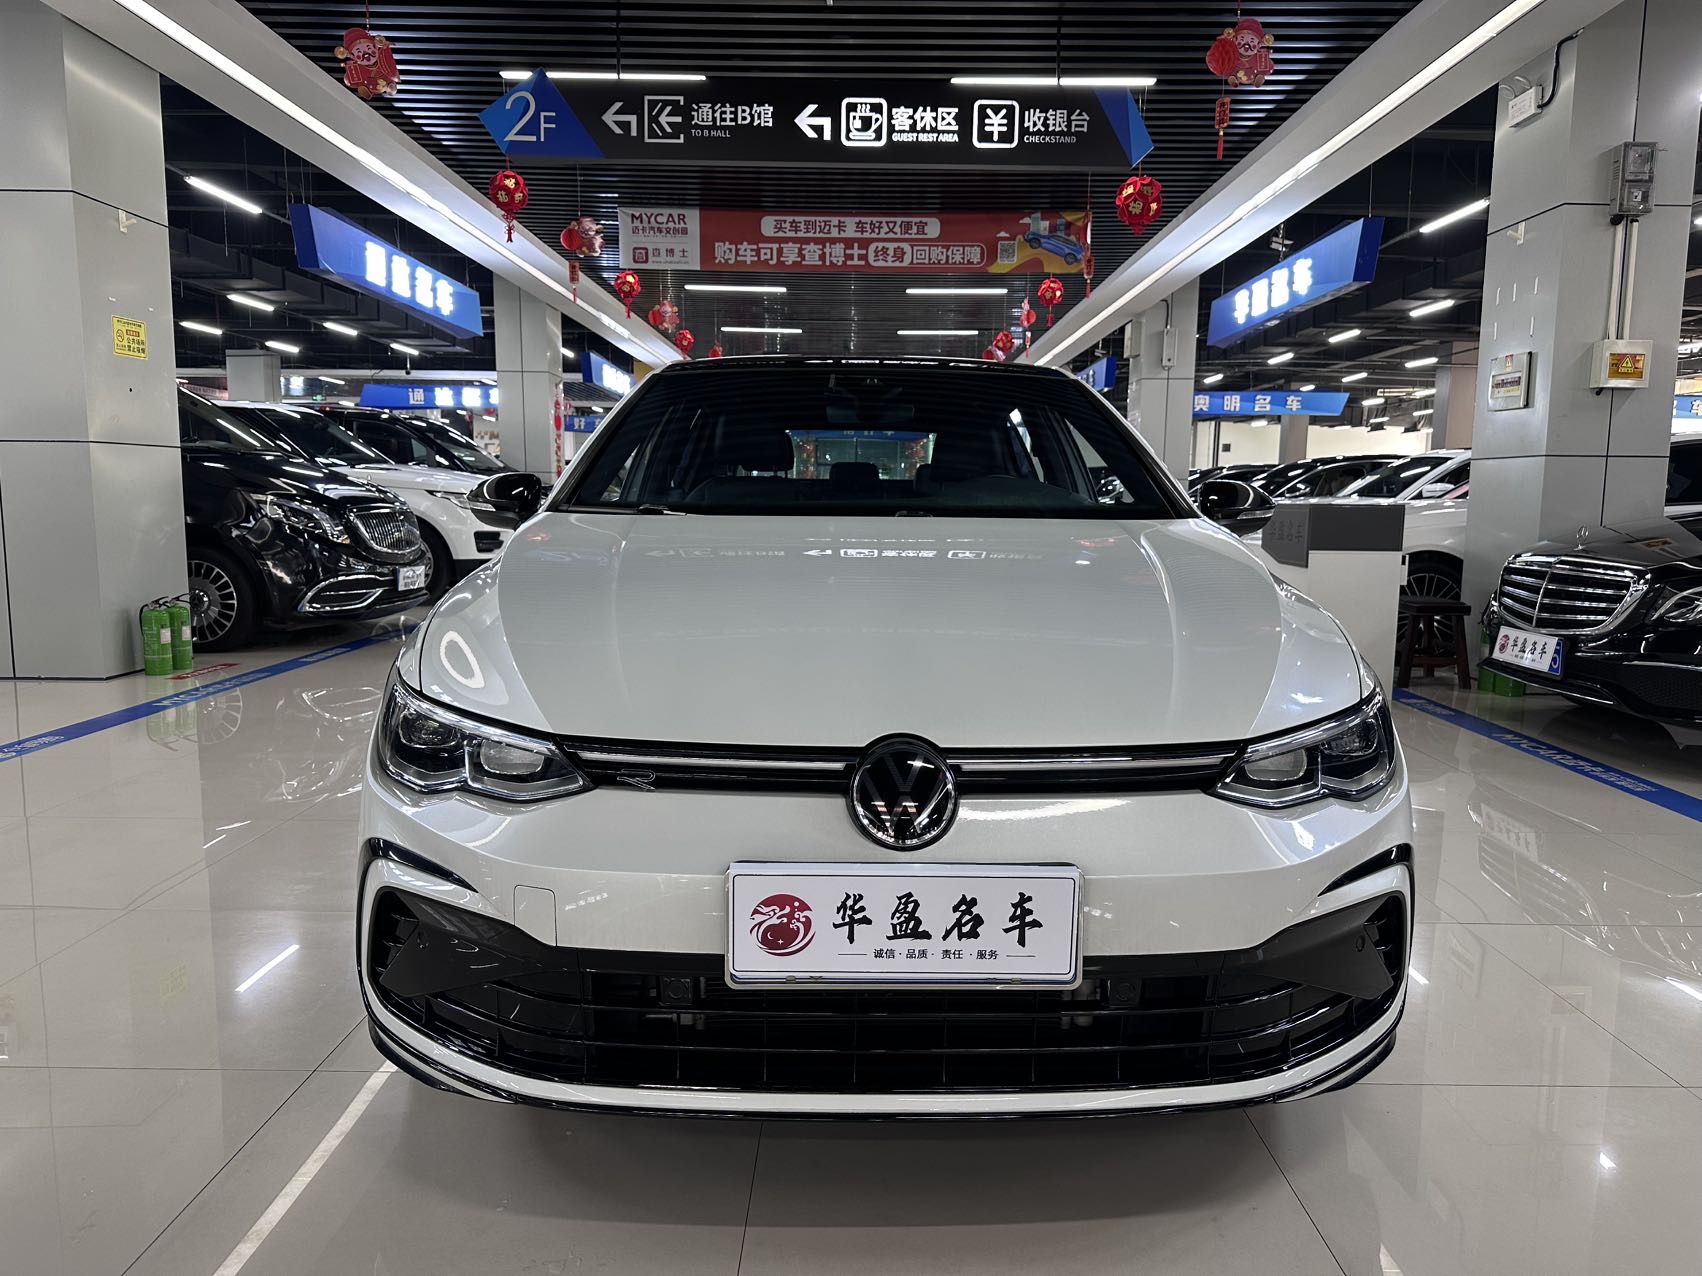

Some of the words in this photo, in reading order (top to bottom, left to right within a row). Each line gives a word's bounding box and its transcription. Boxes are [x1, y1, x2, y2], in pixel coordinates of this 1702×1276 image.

[503, 90, 556, 142] 2F
[691, 103, 774, 128] 通往B馆
[891, 106, 959, 131] 客休区
[1023, 109, 1091, 133] 收银台
[691, 129, 702, 137] TO
[711, 130, 731, 138] HALL
[891, 132, 918, 142] GUEST
[918, 132, 938, 142] REST
[938, 132, 959, 142] AREA
[1023, 135, 1077, 143] CHECKSTAND
[631, 213, 687, 225] MYCAR
[773, 219, 847, 235] 买车到迈卡
[854, 220, 928, 236] 车好又便宜
[632, 226, 688, 235] 迈卡汽车文创园
[1194, 395, 1302, 411] 奥明名车
[1672, 399, 1702, 416] 车
[831, 891, 1044, 947] 华盈名车
